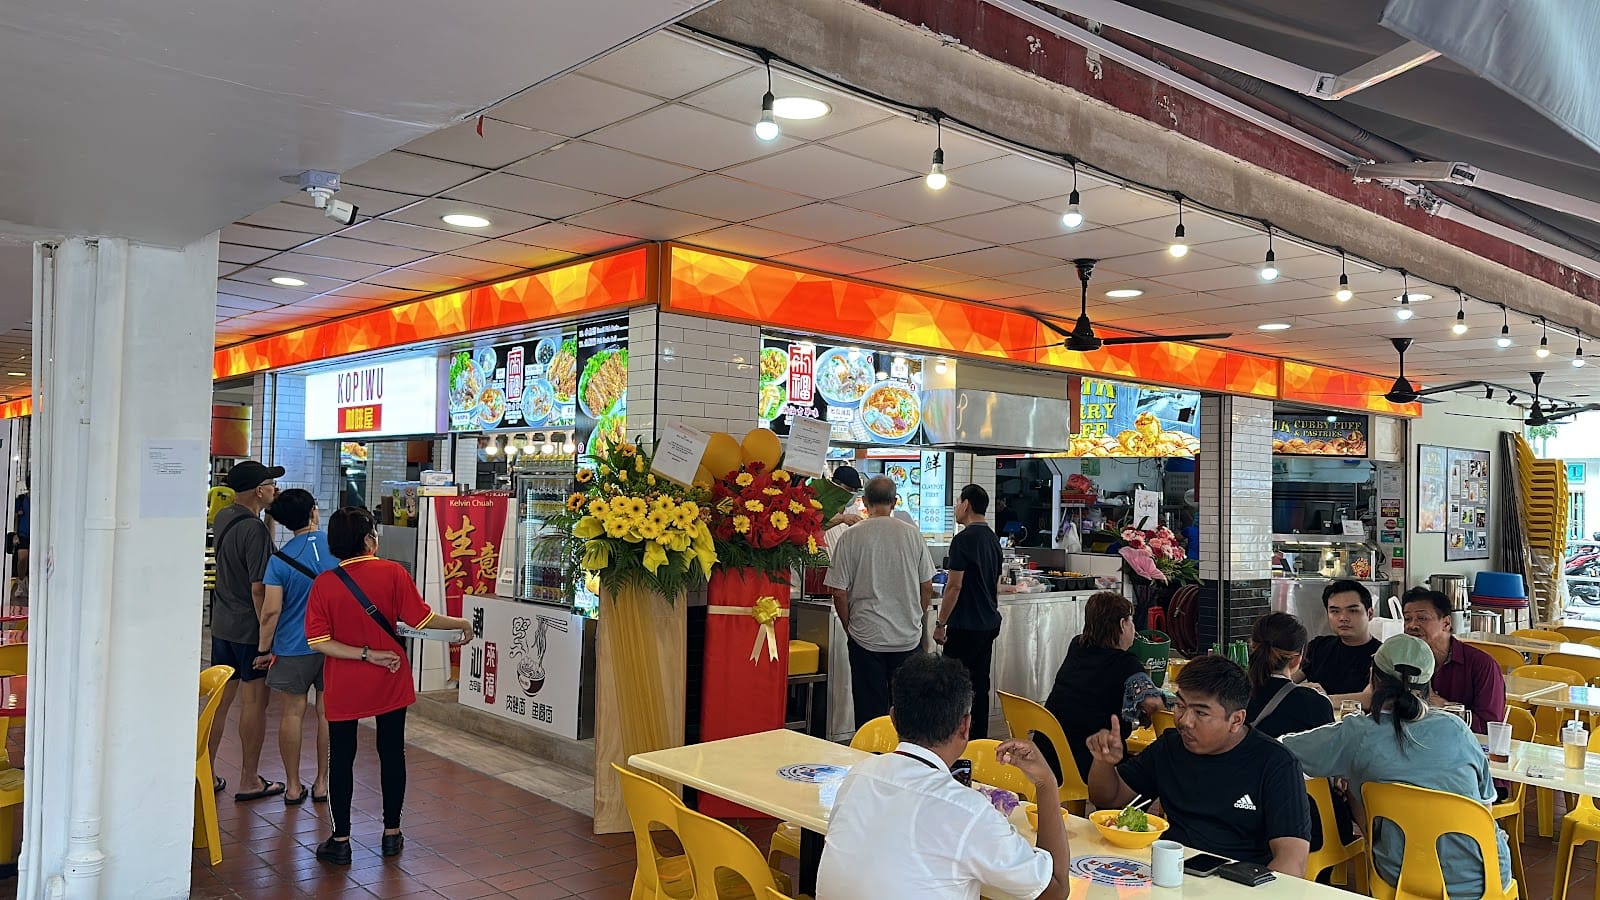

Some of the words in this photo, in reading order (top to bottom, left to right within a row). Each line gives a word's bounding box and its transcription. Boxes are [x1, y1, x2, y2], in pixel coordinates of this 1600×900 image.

[337, 367, 384, 404] KOPIWU
[1334, 421, 1362, 430] PUFF
[449, 499, 471, 507] Kelvin
[472, 499, 494, 507] Chuah
[1233, 802, 1257, 811] adidas
